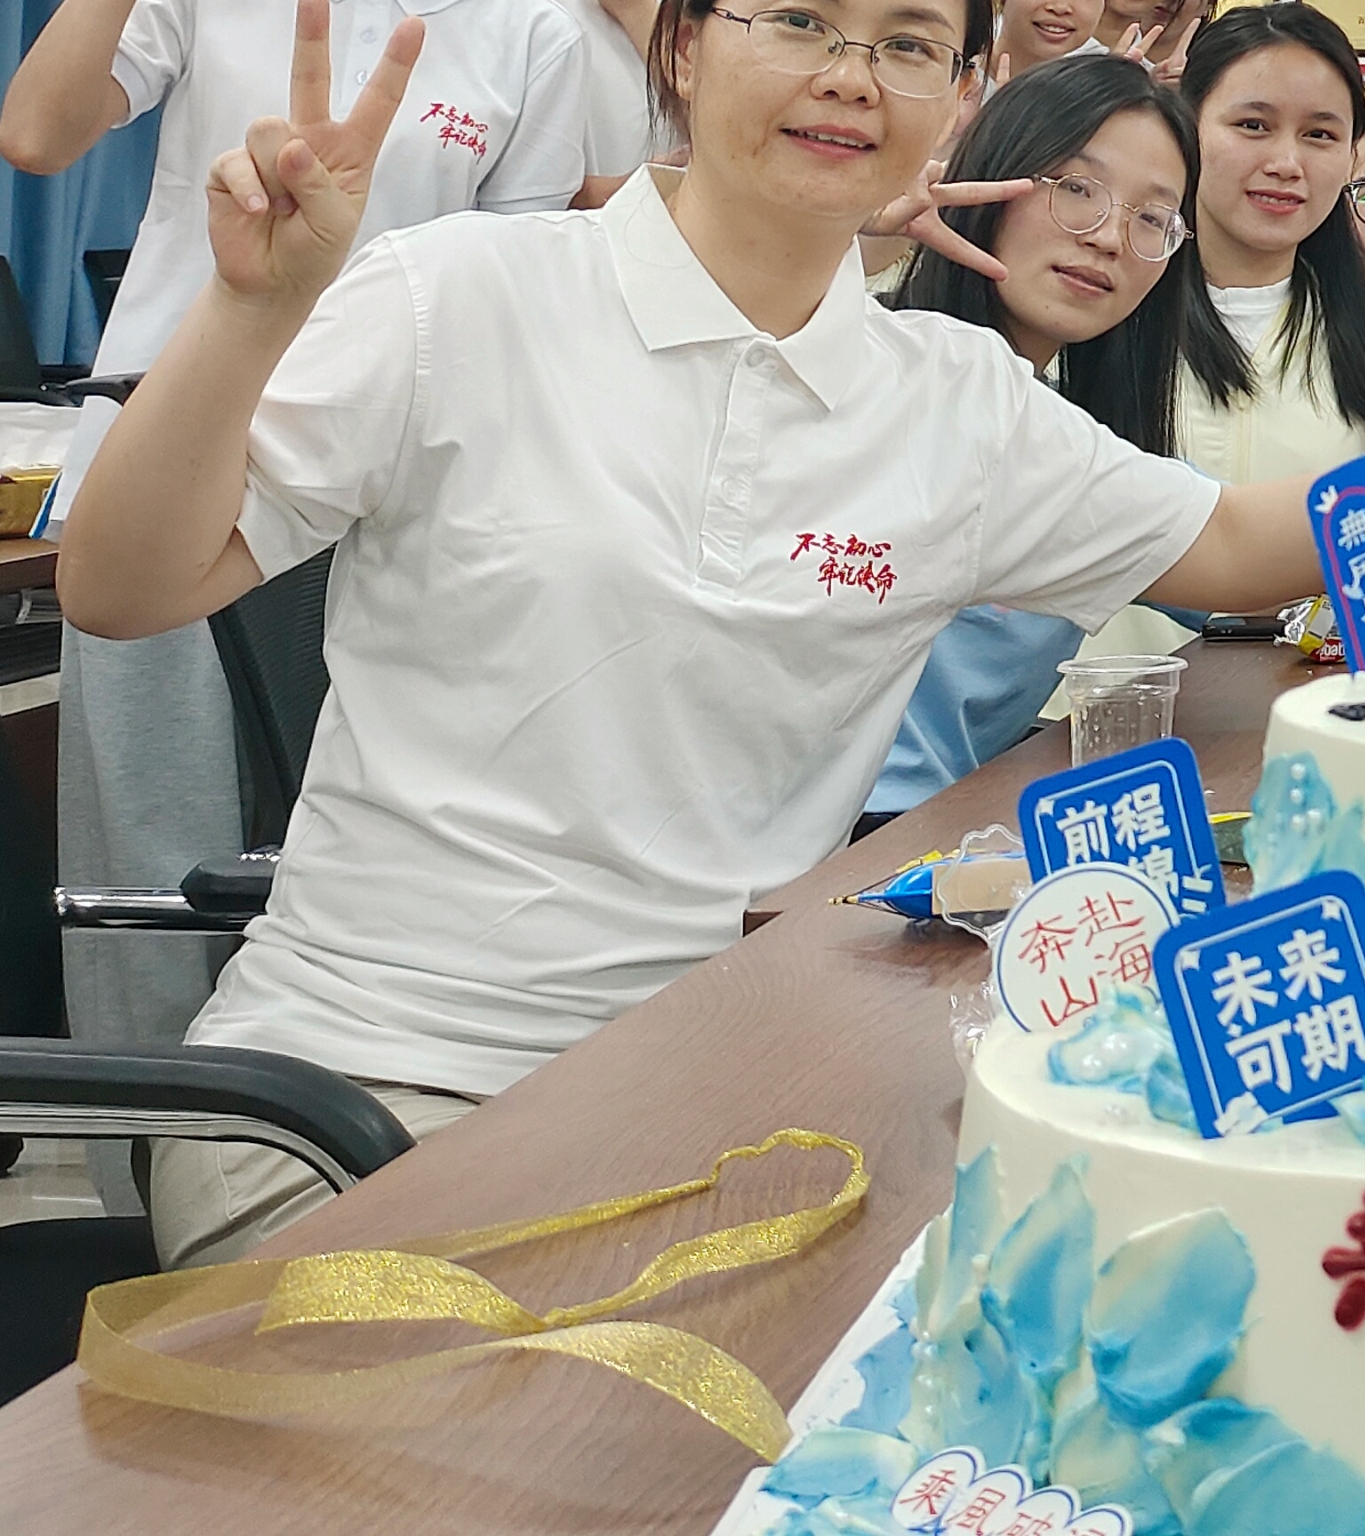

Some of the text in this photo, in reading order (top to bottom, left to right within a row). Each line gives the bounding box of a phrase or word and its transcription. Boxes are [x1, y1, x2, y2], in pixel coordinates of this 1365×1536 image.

[419, 102, 489, 134] 不忘初心
[437, 123, 488, 165] 牢记使命
[789, 532, 892, 562] 不忘初心
[817, 556, 898, 605] 牢记使命
[1055, 782, 1171, 864] 前程
[1018, 891, 1146, 975] 奔赴
[1040, 930, 1152, 1027] 山海
[1211, 928, 1347, 1027] 未来
[899, 1468, 1107, 1536] 乘風破
